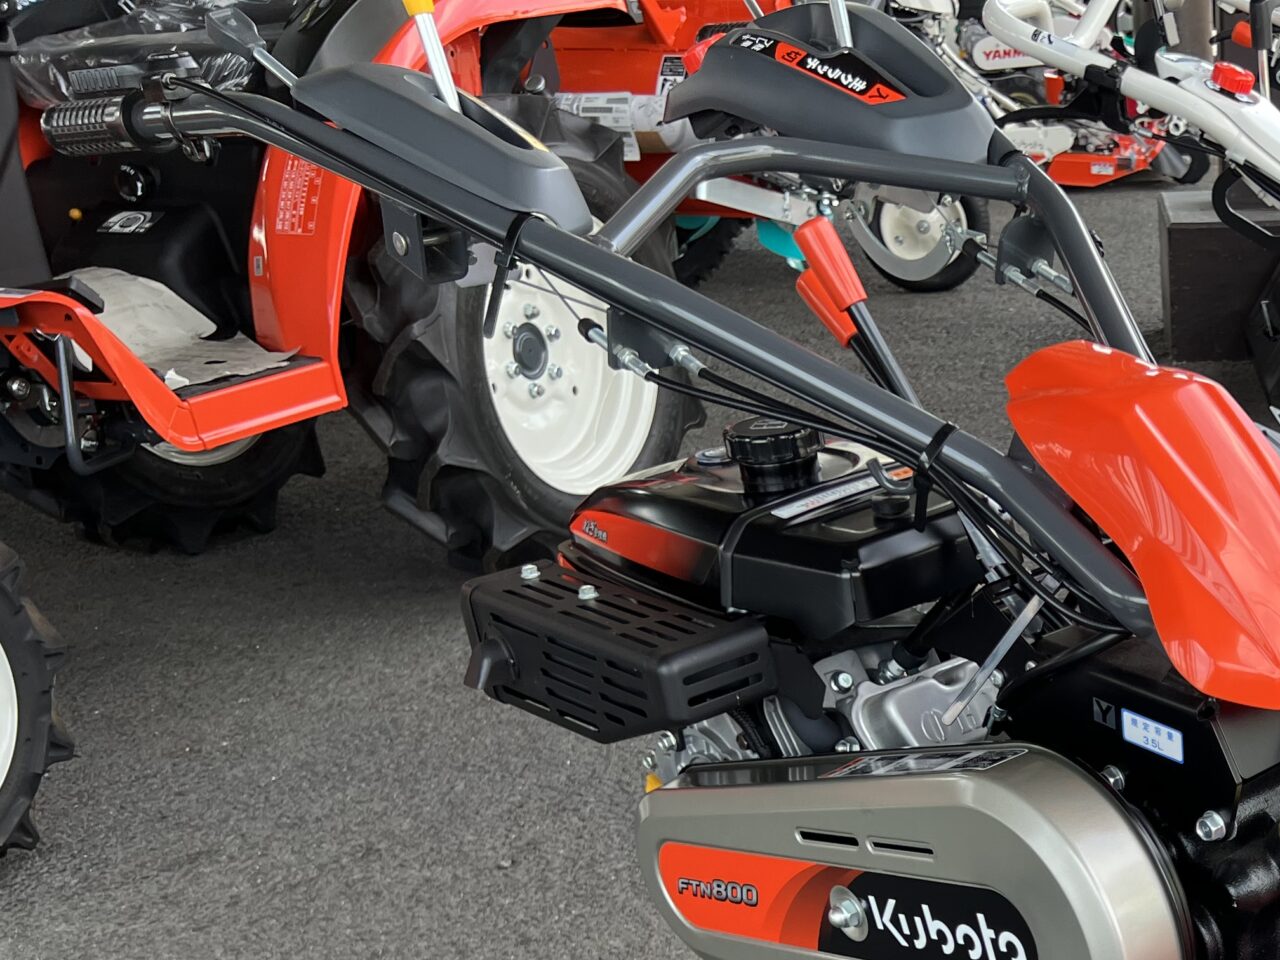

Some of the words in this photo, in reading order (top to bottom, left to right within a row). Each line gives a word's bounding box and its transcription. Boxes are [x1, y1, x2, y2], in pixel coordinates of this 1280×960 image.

[805, 56, 867, 92] 主クラッチ
[677, 877, 759, 907] FTN800
